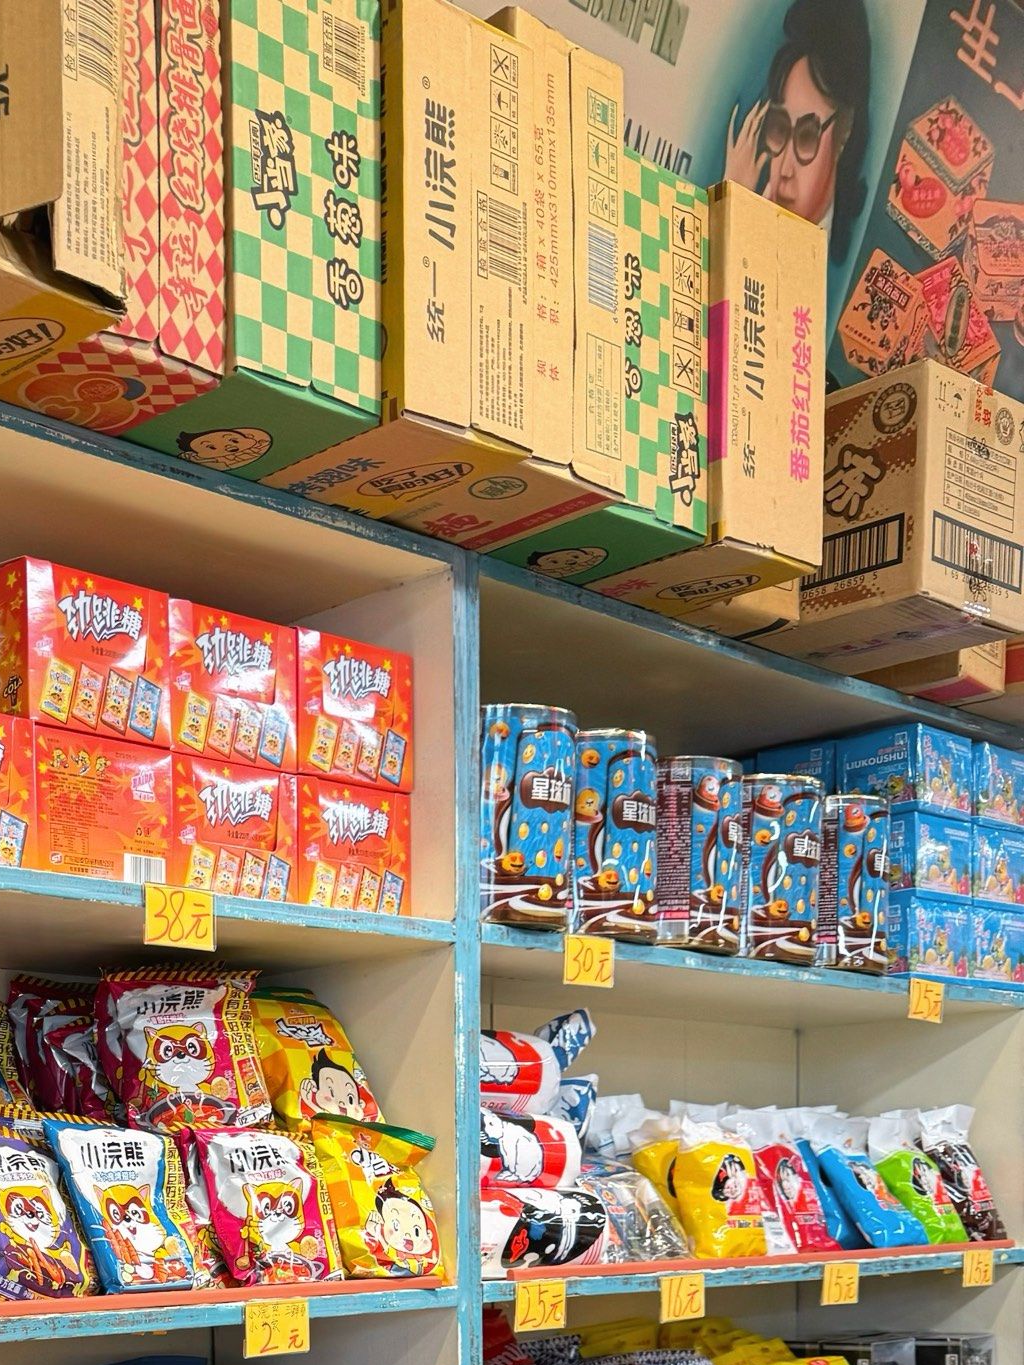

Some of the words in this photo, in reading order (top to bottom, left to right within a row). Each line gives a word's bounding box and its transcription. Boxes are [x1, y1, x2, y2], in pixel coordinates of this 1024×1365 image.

[424, 98, 457, 251] 小浣熊
[324, 129, 364, 311] 香葱味
[426, 261, 446, 343] 统一
[743, 274, 766, 401] 小浣熊
[788, 307, 812, 482] 番茄红烩味
[743, 410, 756, 479] 统一
[833, 575, 866, 590] 26859
[153, 890, 209, 943] 38元
[136, 989, 205, 1015] 小浣熊
[80, 1140, 146, 1170] 小浣熊
[260, 1321, 304, 1354] 2元
[523, 1288, 564, 1326] 25元
